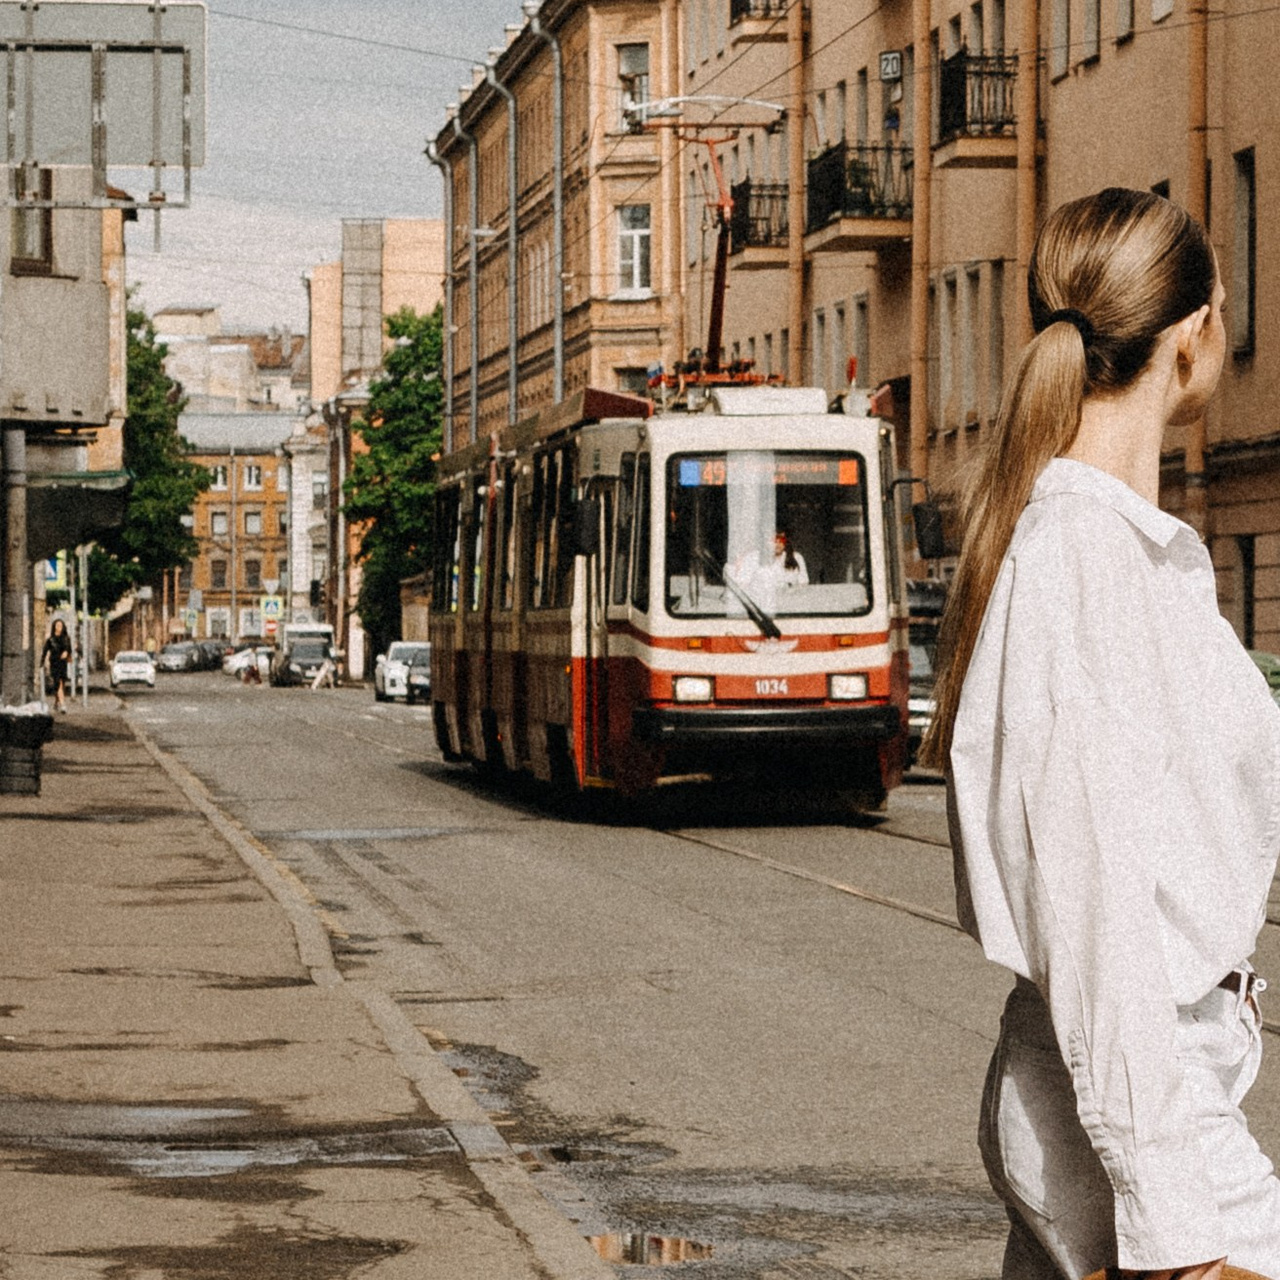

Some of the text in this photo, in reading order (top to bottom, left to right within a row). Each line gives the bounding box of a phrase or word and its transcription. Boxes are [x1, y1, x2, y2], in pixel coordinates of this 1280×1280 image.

[882, 55, 899, 76] 20
[702, 461, 726, 485] 49
[755, 678, 788, 695] 1034
